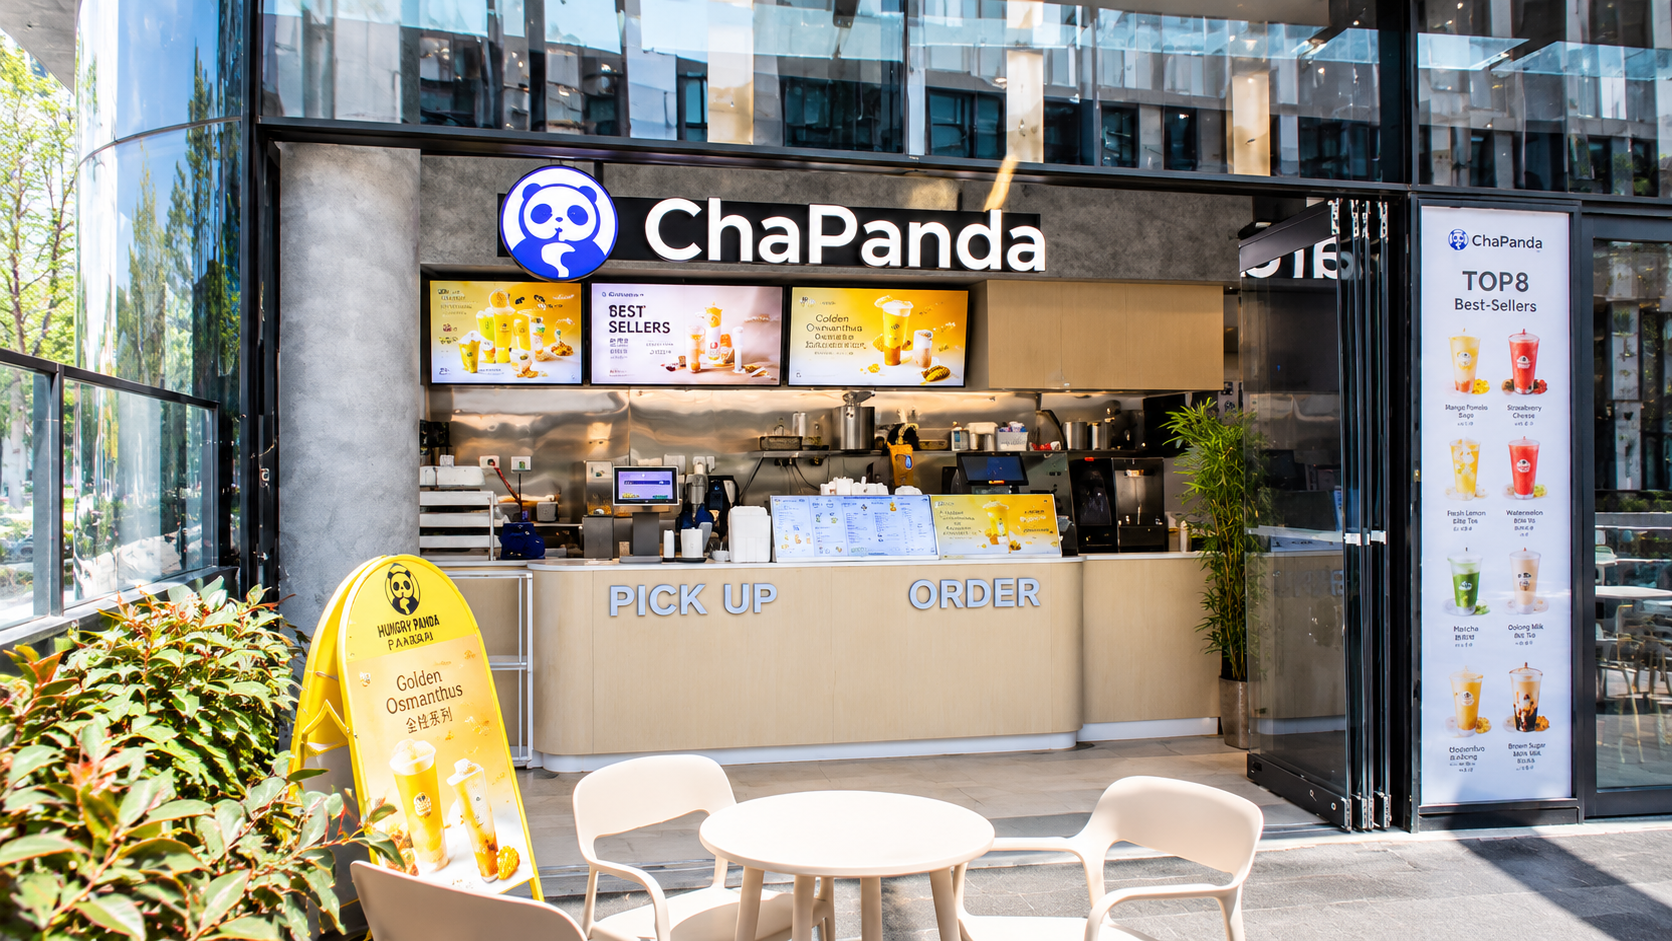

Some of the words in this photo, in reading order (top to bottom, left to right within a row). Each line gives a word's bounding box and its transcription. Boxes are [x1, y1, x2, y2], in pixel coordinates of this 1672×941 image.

[644, 197, 1047, 272] ChaPanda
[1472, 234, 1543, 250] ChaPanda
[1462, 270, 1529, 293] TOP8
[1454, 298, 1537, 312] Best-Sellers
[608, 320, 671, 334] SELLERS
[608, 583, 708, 617] PICK
[723, 582, 778, 615] UP
[908, 577, 1041, 610] ORDER
[376, 619, 411, 638] HUNGRY
[412, 614, 440, 630] PANDA
[396, 669, 443, 692] Golden
[386, 684, 463, 715] Osmanthus
